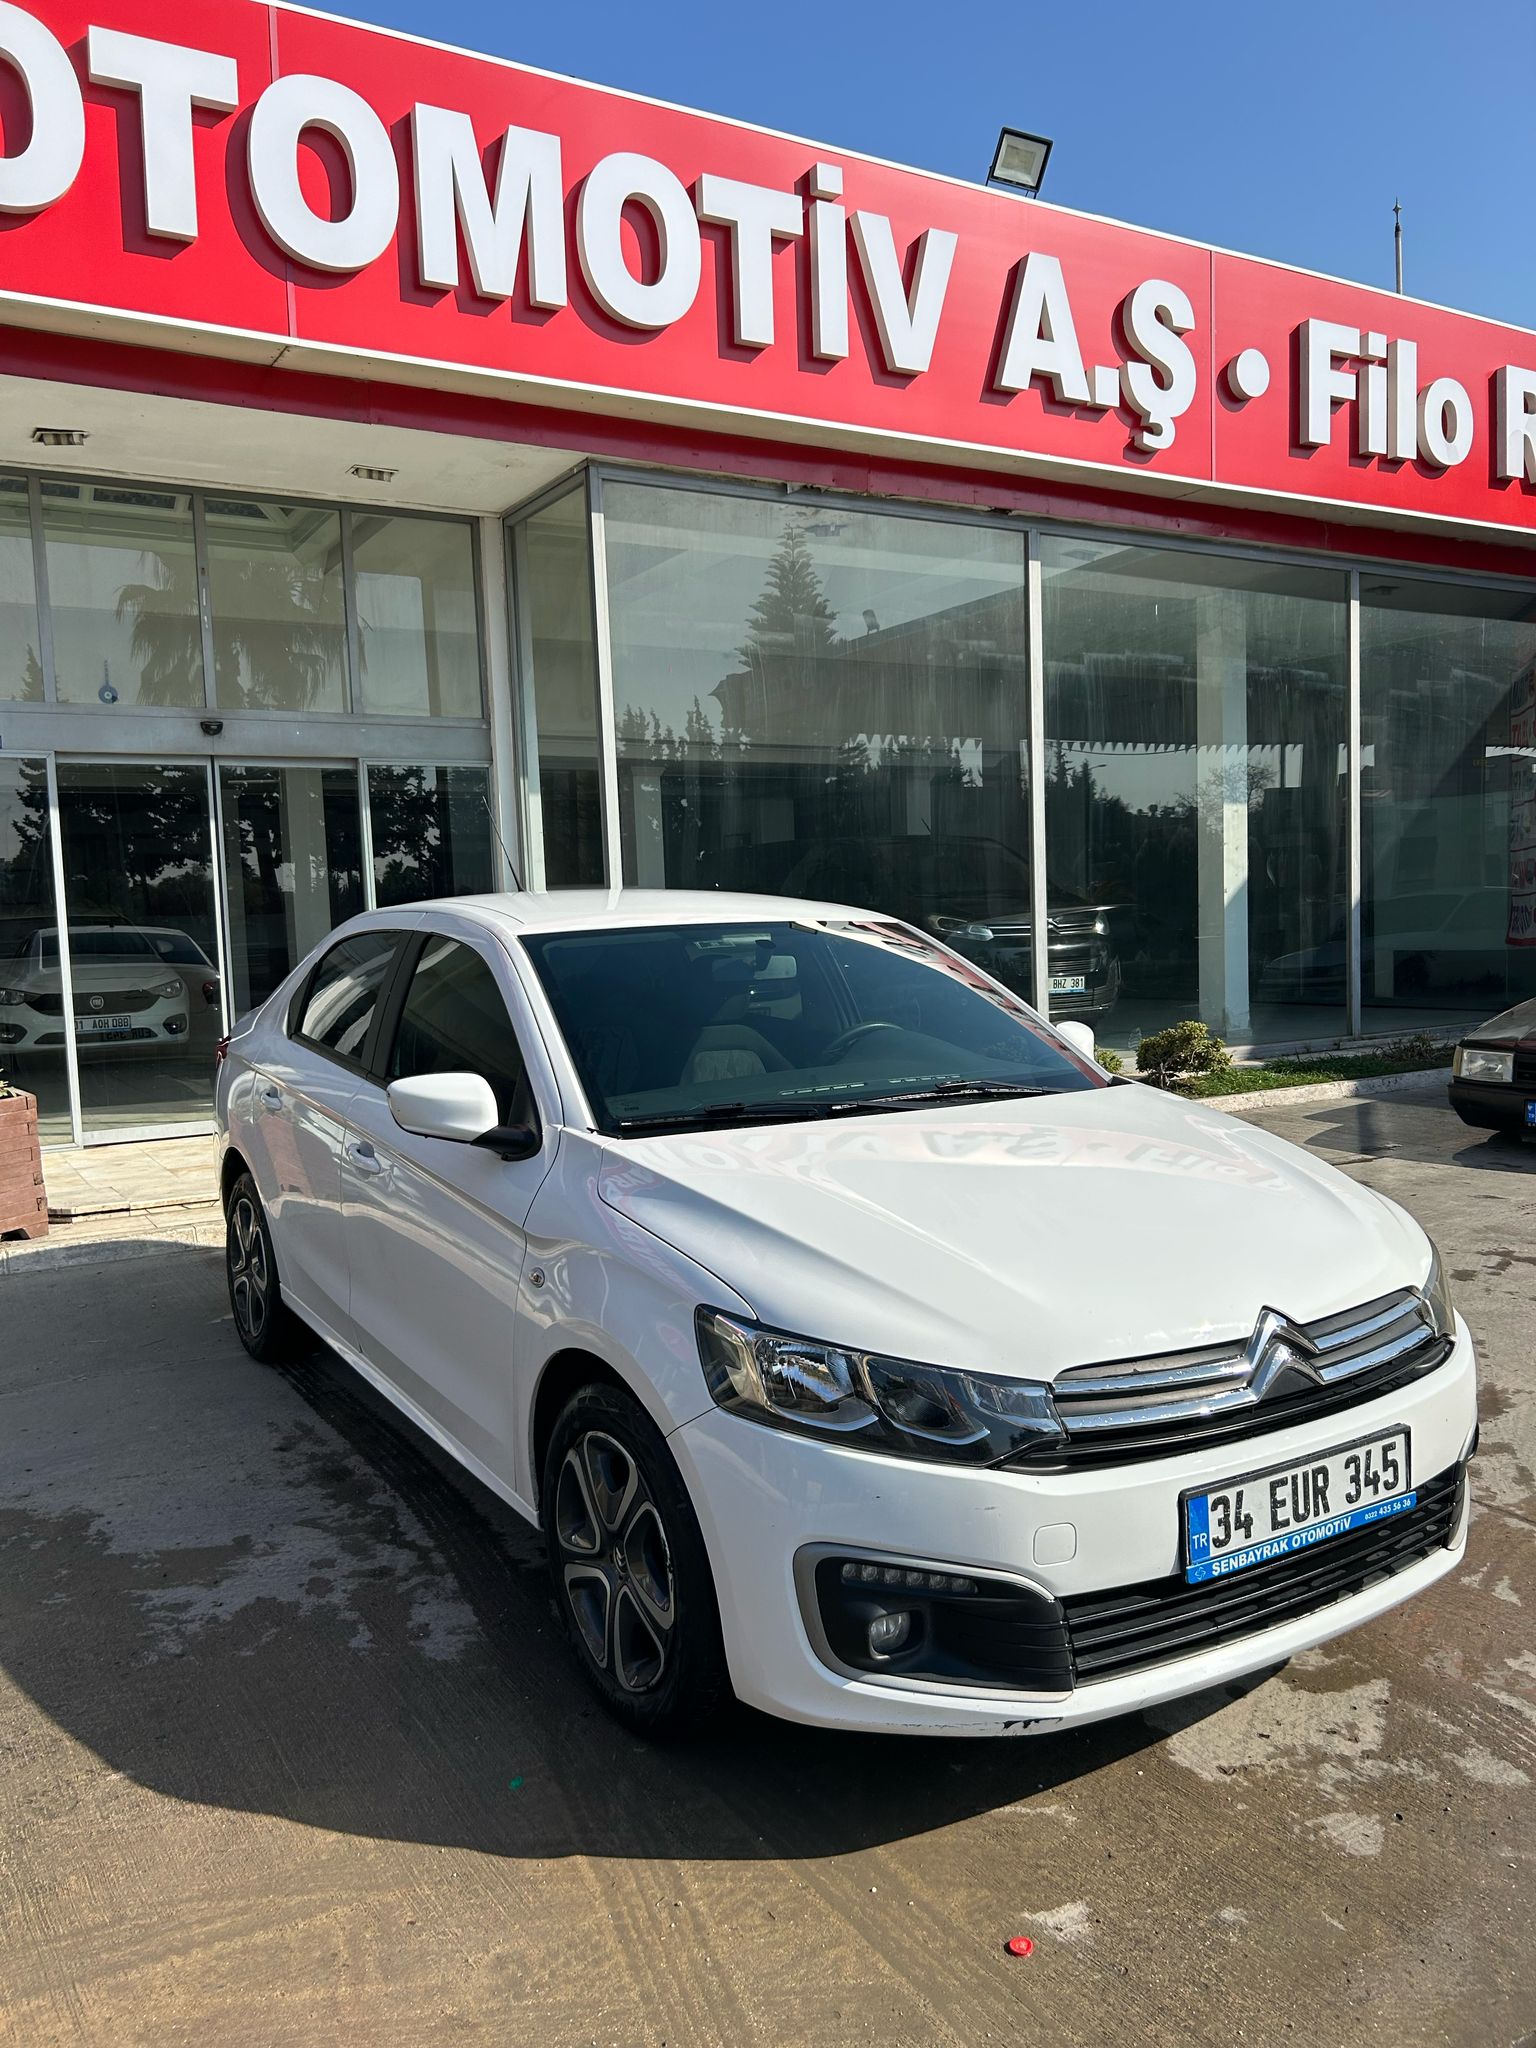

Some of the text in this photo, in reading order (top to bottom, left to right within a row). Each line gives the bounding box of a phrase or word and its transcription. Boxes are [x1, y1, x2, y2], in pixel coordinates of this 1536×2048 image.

[1299, 318, 1474, 467] Filo
[1053, 977, 1084, 989] BHZ 381
[1211, 1441, 1400, 1549] 34 EUR 345
[1379, 1503, 1392, 1515] 435
[1393, 1501, 1402, 1511] 56
[1402, 1497, 1411, 1507] 36
[1192, 1532, 1208, 1550] TR
